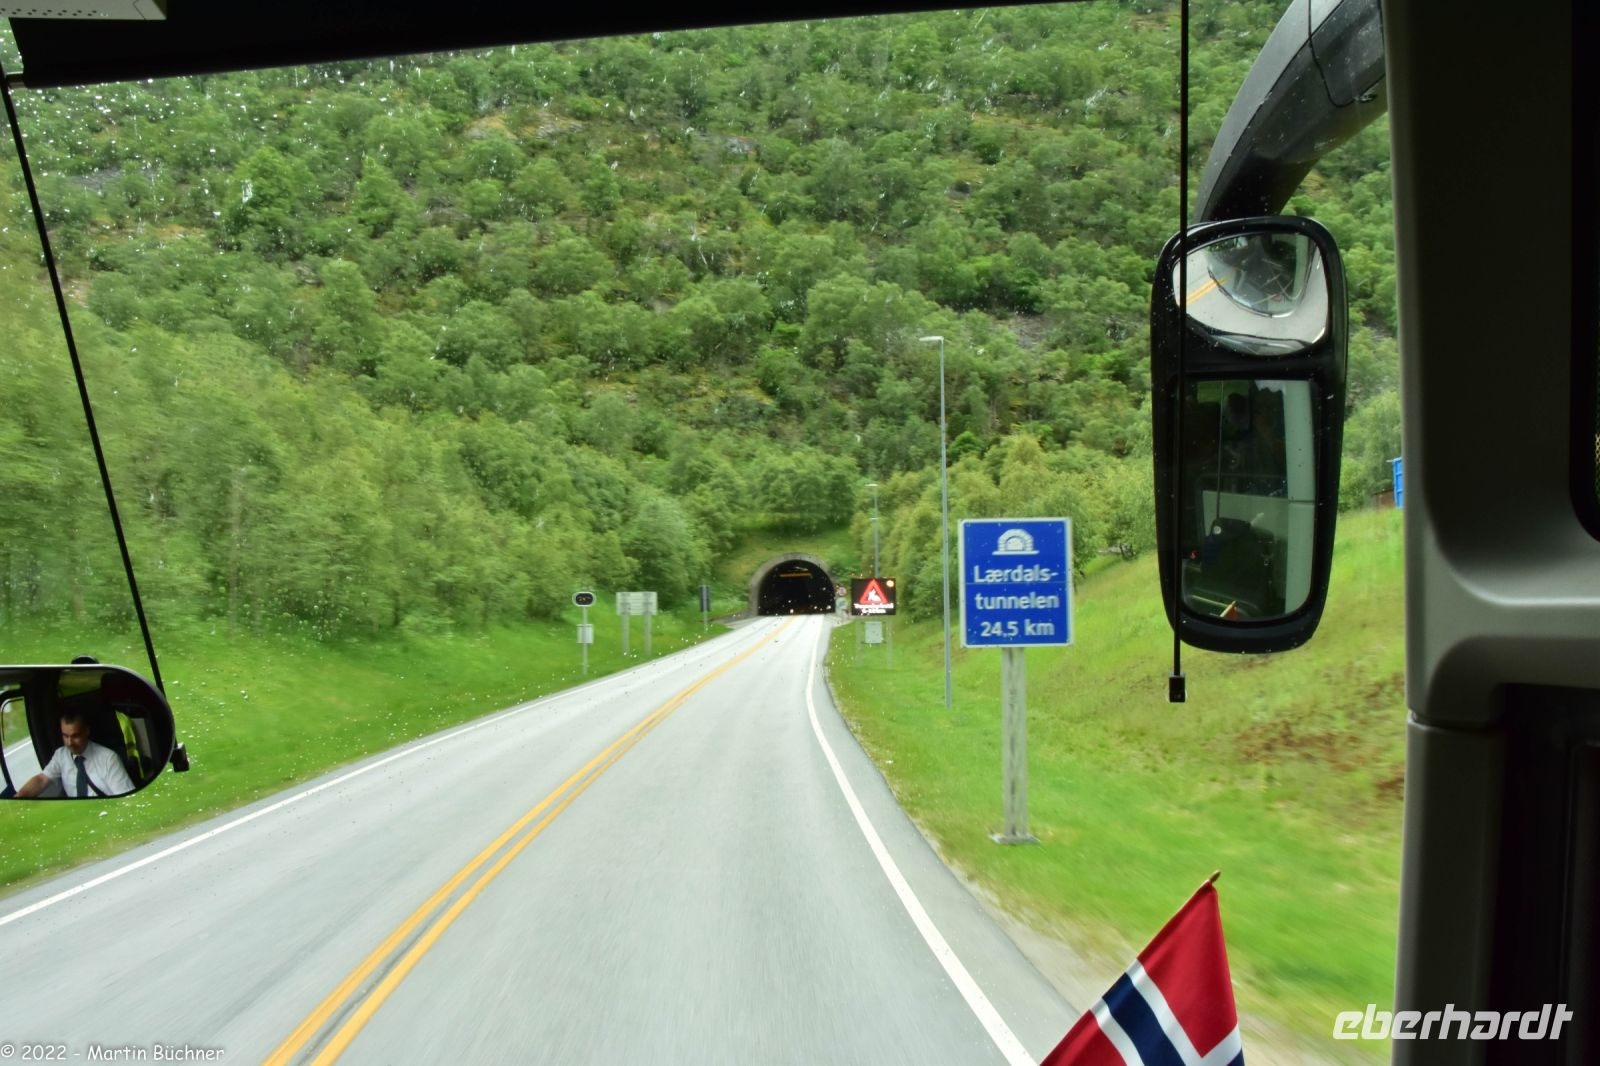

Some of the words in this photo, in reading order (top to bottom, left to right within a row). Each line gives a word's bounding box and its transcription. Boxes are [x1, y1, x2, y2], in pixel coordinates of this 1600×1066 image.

[974, 564, 1058, 583] Lærdals-
[975, 592, 1059, 609] tunnelen
[1024, 619, 1055, 636] km
